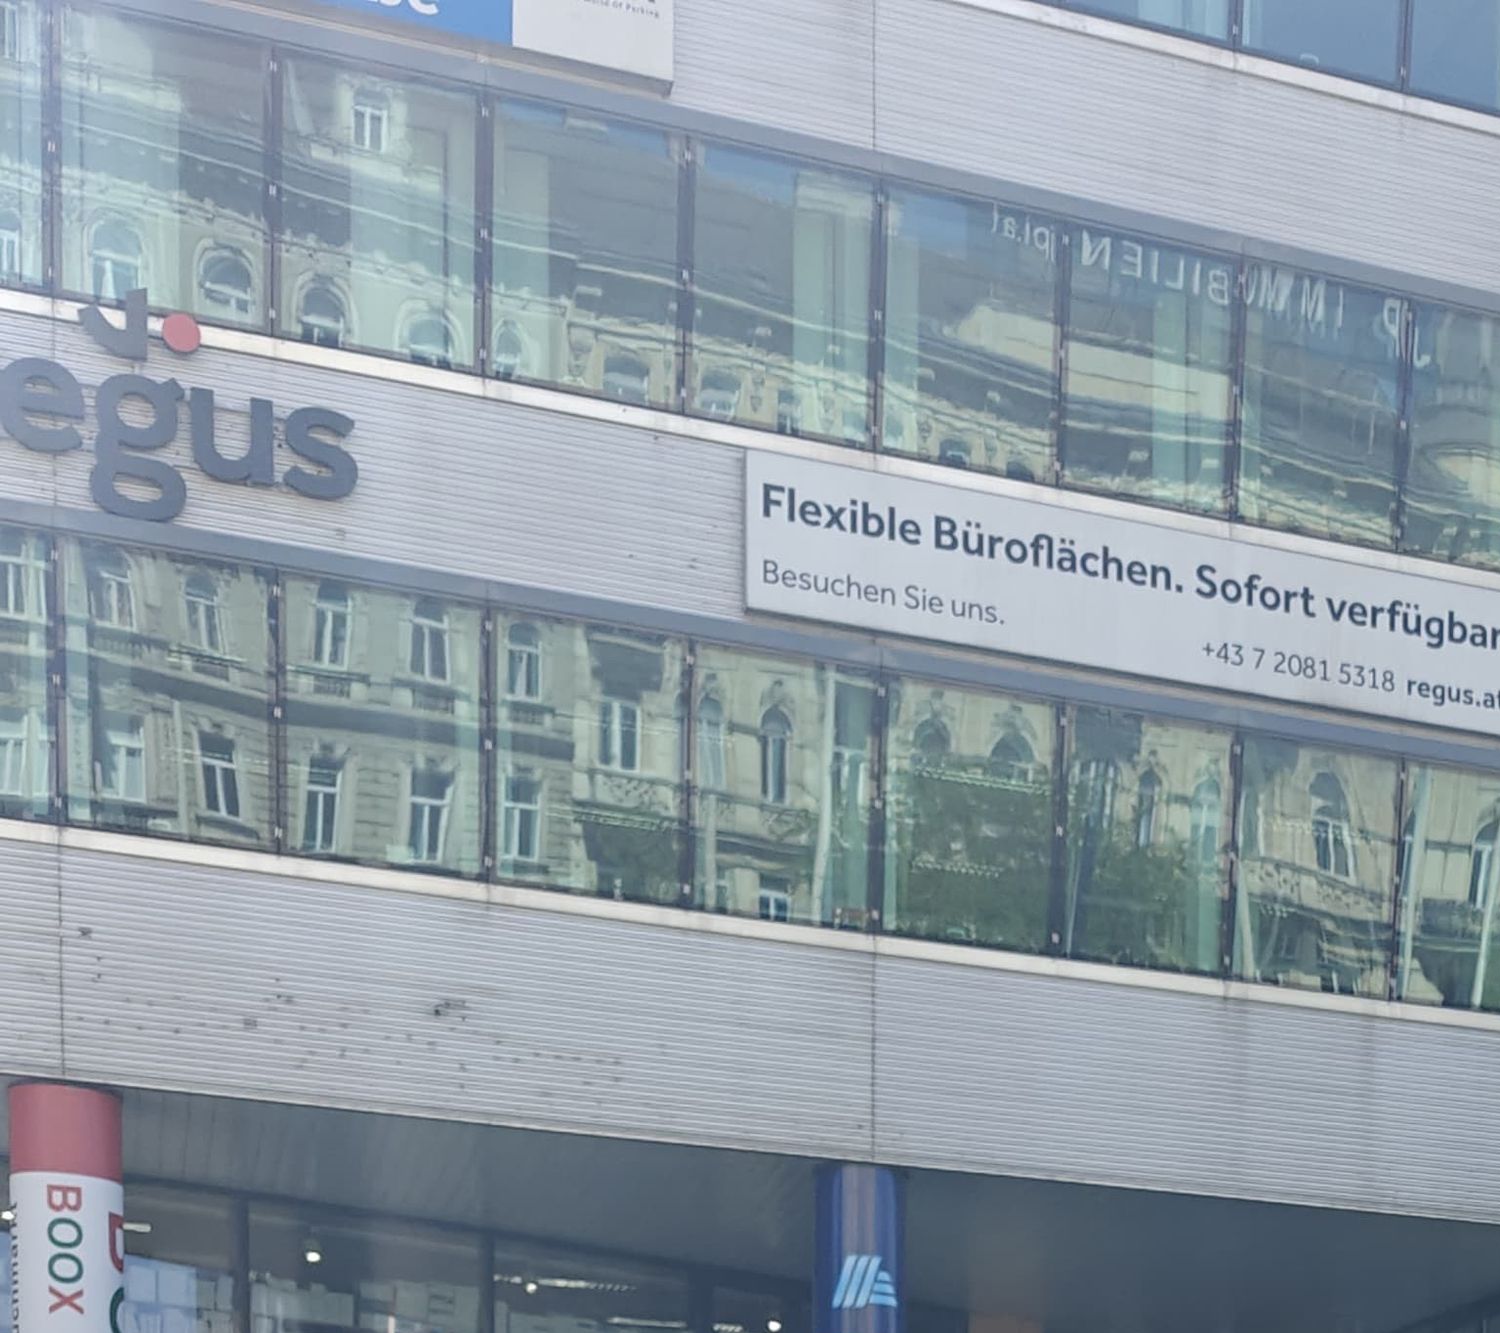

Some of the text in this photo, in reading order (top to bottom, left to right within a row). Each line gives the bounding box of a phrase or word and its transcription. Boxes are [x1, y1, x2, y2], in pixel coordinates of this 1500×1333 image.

[0, 356, 359, 521] egus
[761, 483, 922, 546] Flexible
[933, 515, 1184, 593] Büroflächen.
[1195, 563, 1316, 618] Sofort
[762, 559, 1006, 625] Besuchen Sie uns.
[1201, 642, 1245, 669] +43
[1252, 648, 1266, 670] 7
[1273, 651, 1331, 682] 2081
[1338, 661, 1396, 693] 5318
[46, 1184, 84, 1314] BOOX
